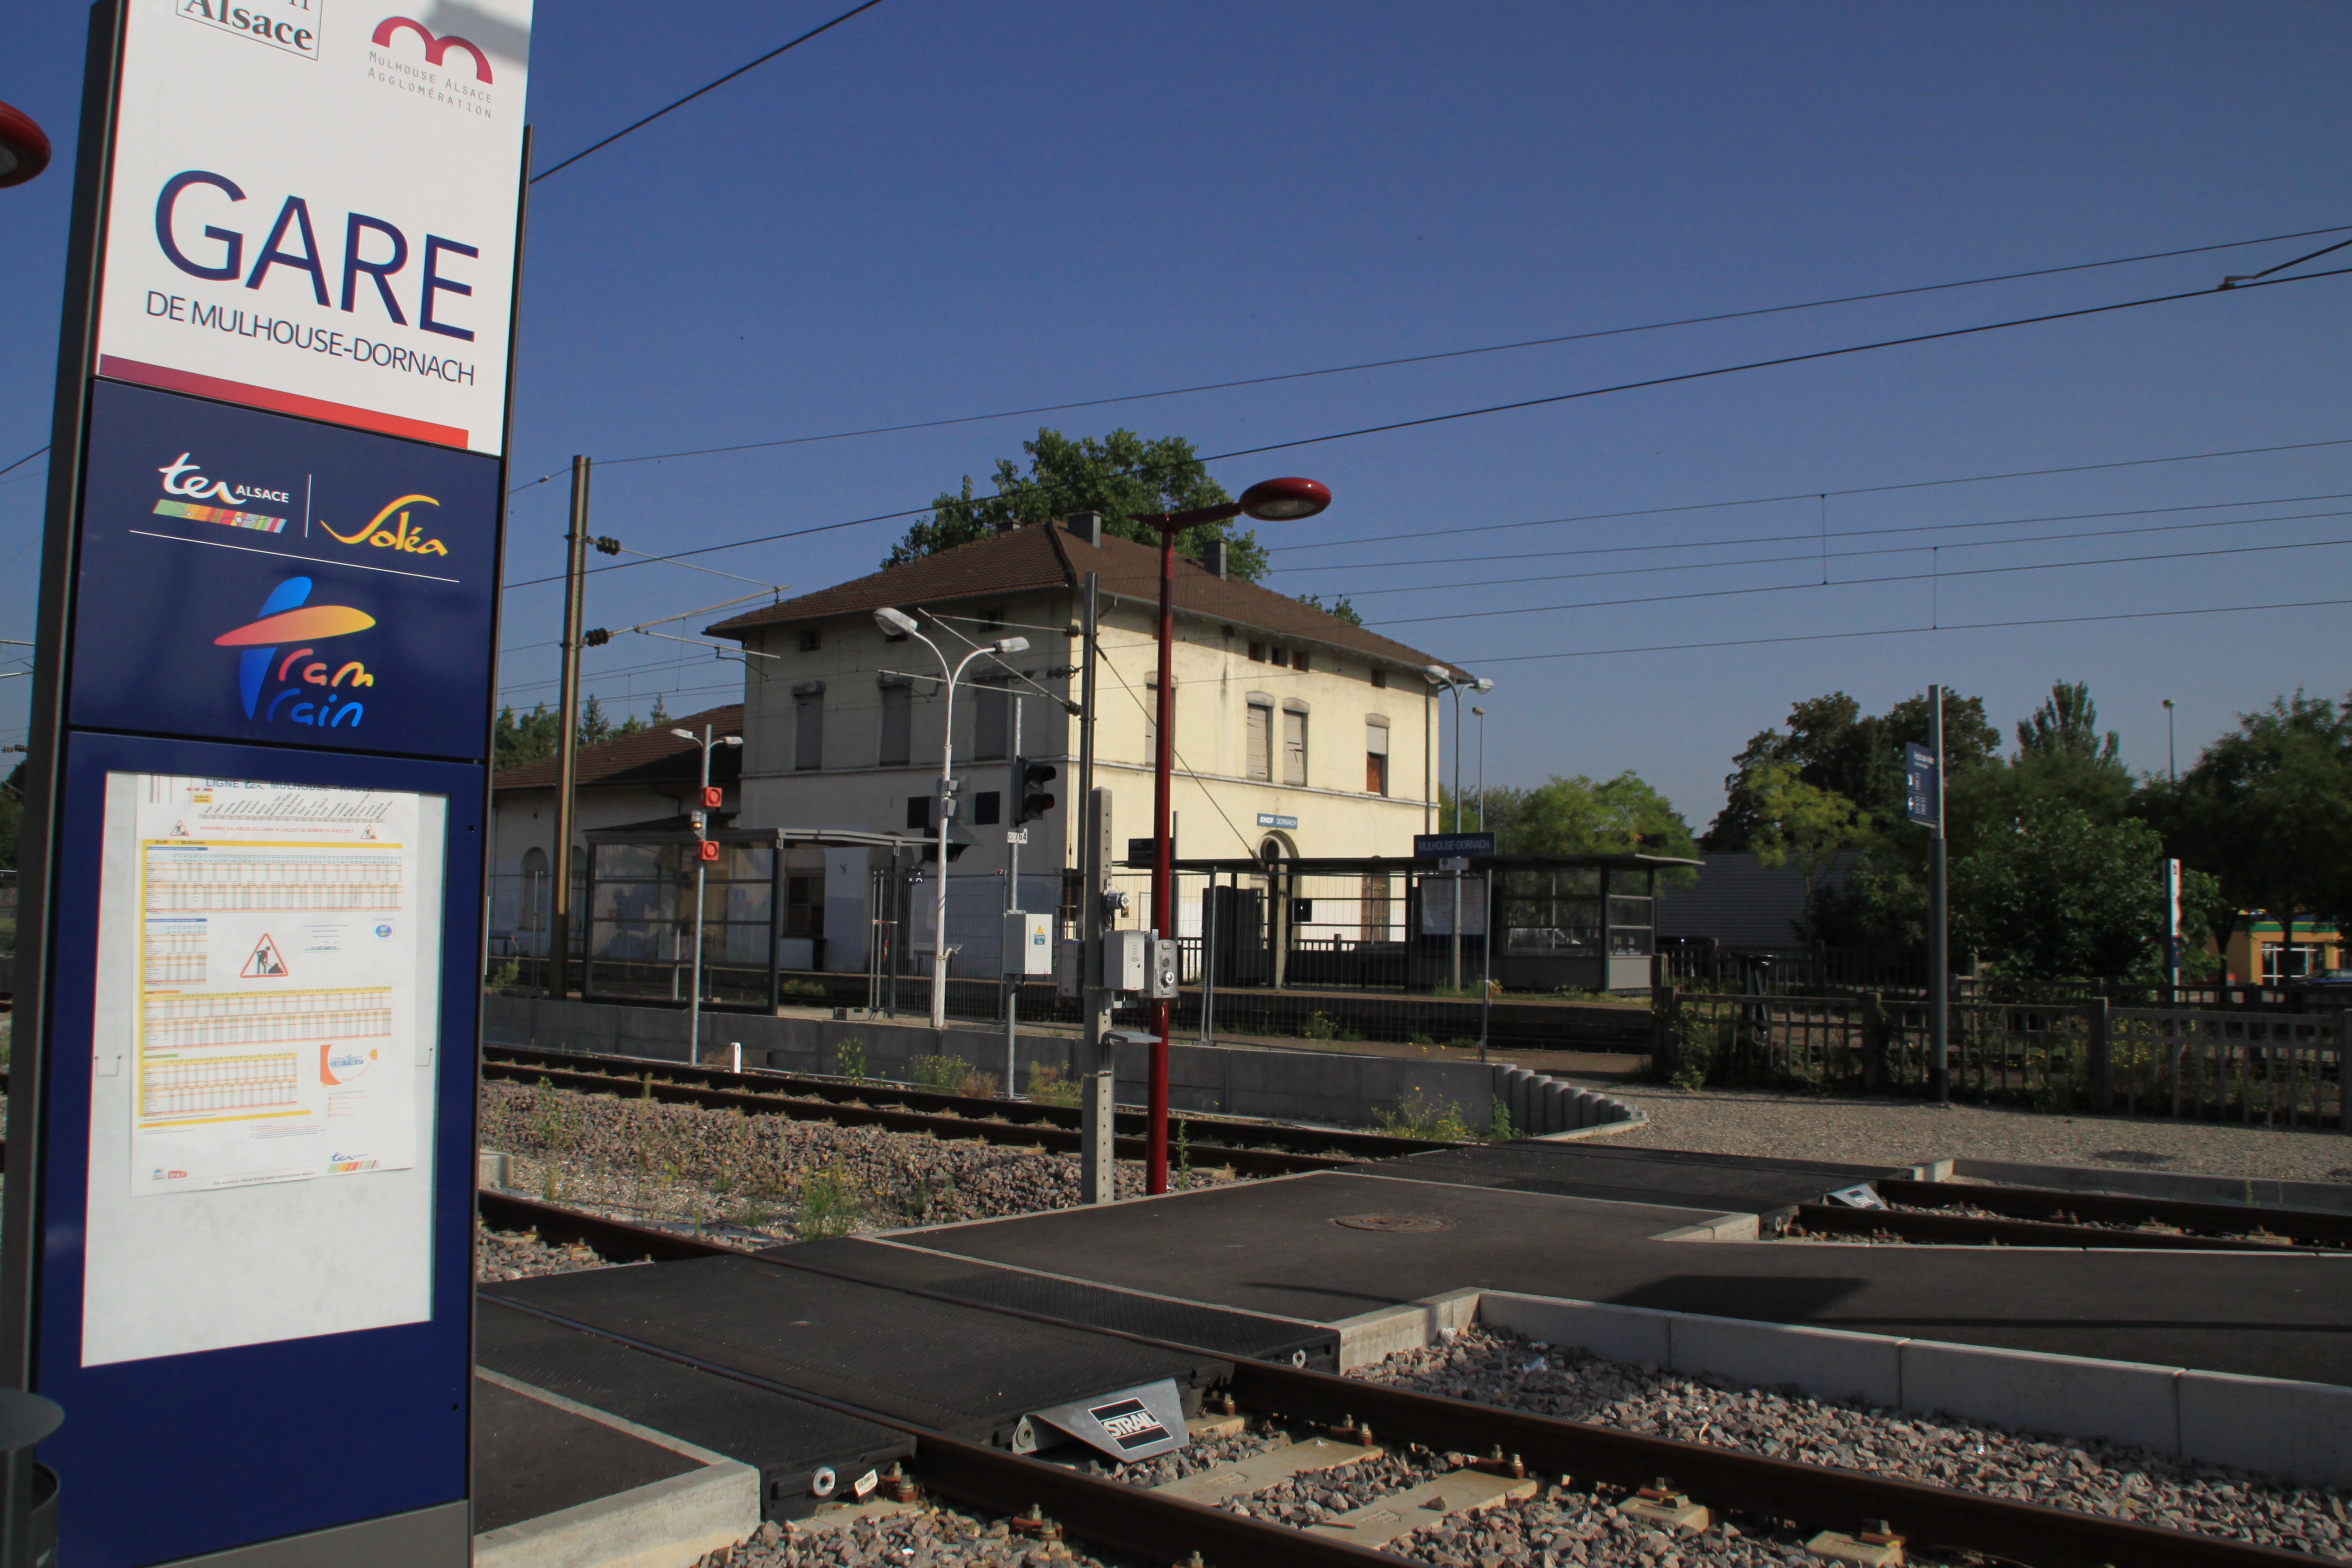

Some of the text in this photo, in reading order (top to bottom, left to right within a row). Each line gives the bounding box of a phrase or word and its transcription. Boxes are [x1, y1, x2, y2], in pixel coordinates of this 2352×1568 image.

[183, 0, 314, 51] Alsace
[368, 50, 493, 104] MULHOUSE ALSACE
[368, 67, 492, 119] AGGLOMÉRATION
[155, 170, 480, 343] GARE
[146, 290, 476, 386] DE MULHOUSE-DORNACH
[236, 484, 290, 504] ALSACE
[205, 779, 240, 788] LIGNE
[1276, 817, 1298, 826] DORNACH
[1418, 839, 1490, 852] MULHOUSE-DORNACH
[1104, 1411, 1160, 1438] STRAIL
